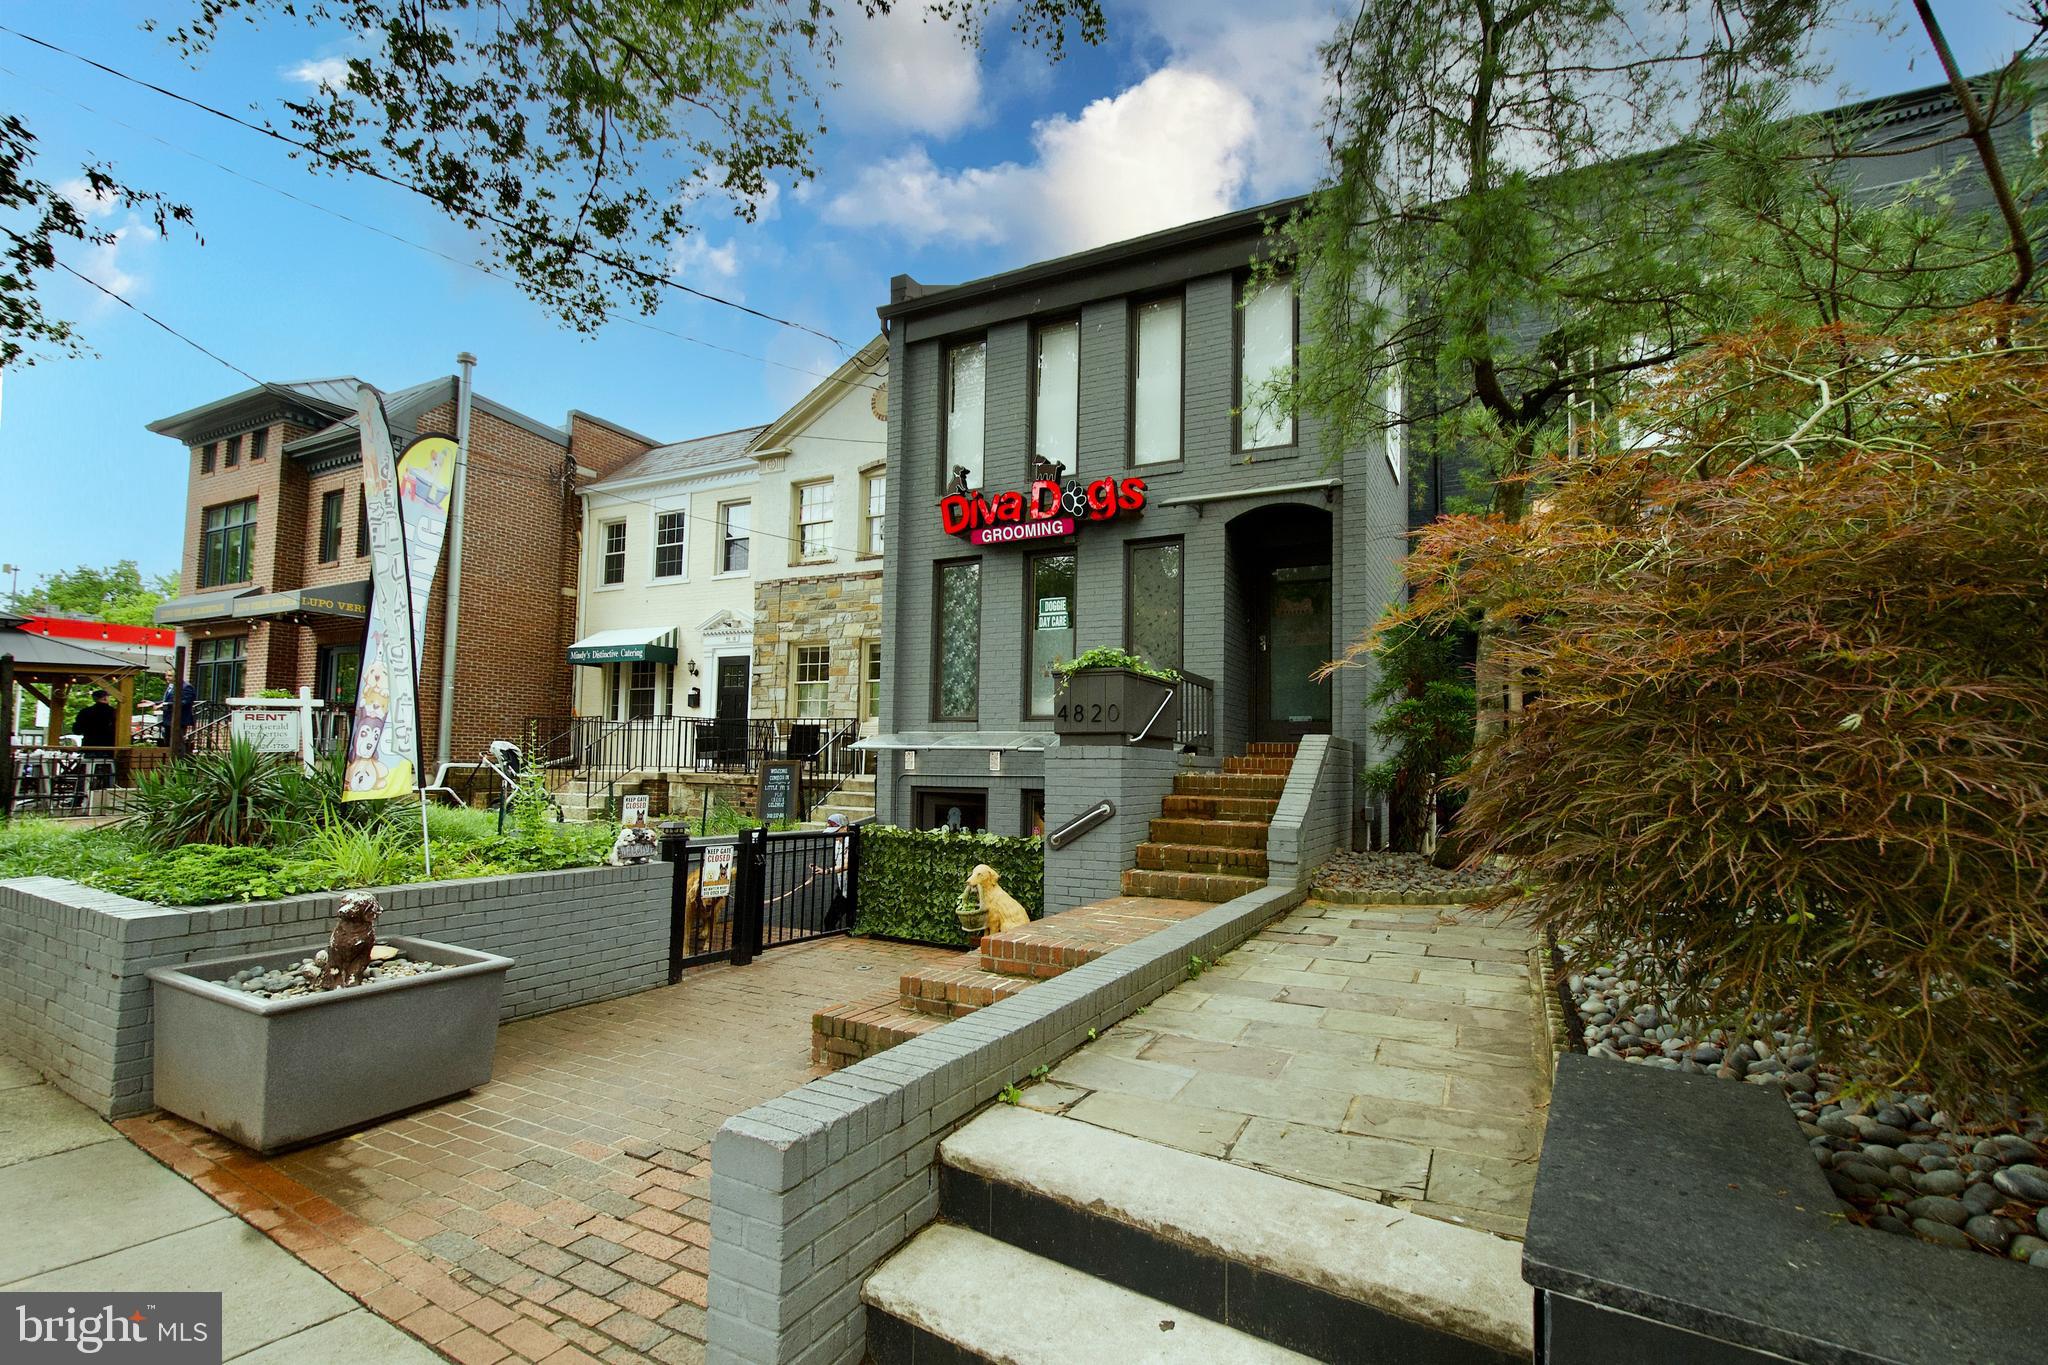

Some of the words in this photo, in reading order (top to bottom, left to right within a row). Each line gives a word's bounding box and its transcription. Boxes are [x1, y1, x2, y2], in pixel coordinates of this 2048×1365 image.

[940, 490, 1022, 535] Diva
[981, 520, 1064, 543] GROOMING
[301, 596, 334, 609] LUPO
[337, 601, 366, 613] VER
[1044, 600, 1067, 612] DOGGIE
[1039, 616, 1051, 627] DAY
[1051, 615, 1067, 627] CARE
[570, 651, 591, 660] Mindy's
[592, 649, 619, 659] Distinctive
[620, 648, 644, 658] Catering
[244, 713, 287, 721] RENT
[1057, 703, 1120, 723] 4820
[625, 802, 647, 810] CLOSED
[707, 854, 731, 863] CLOSED
